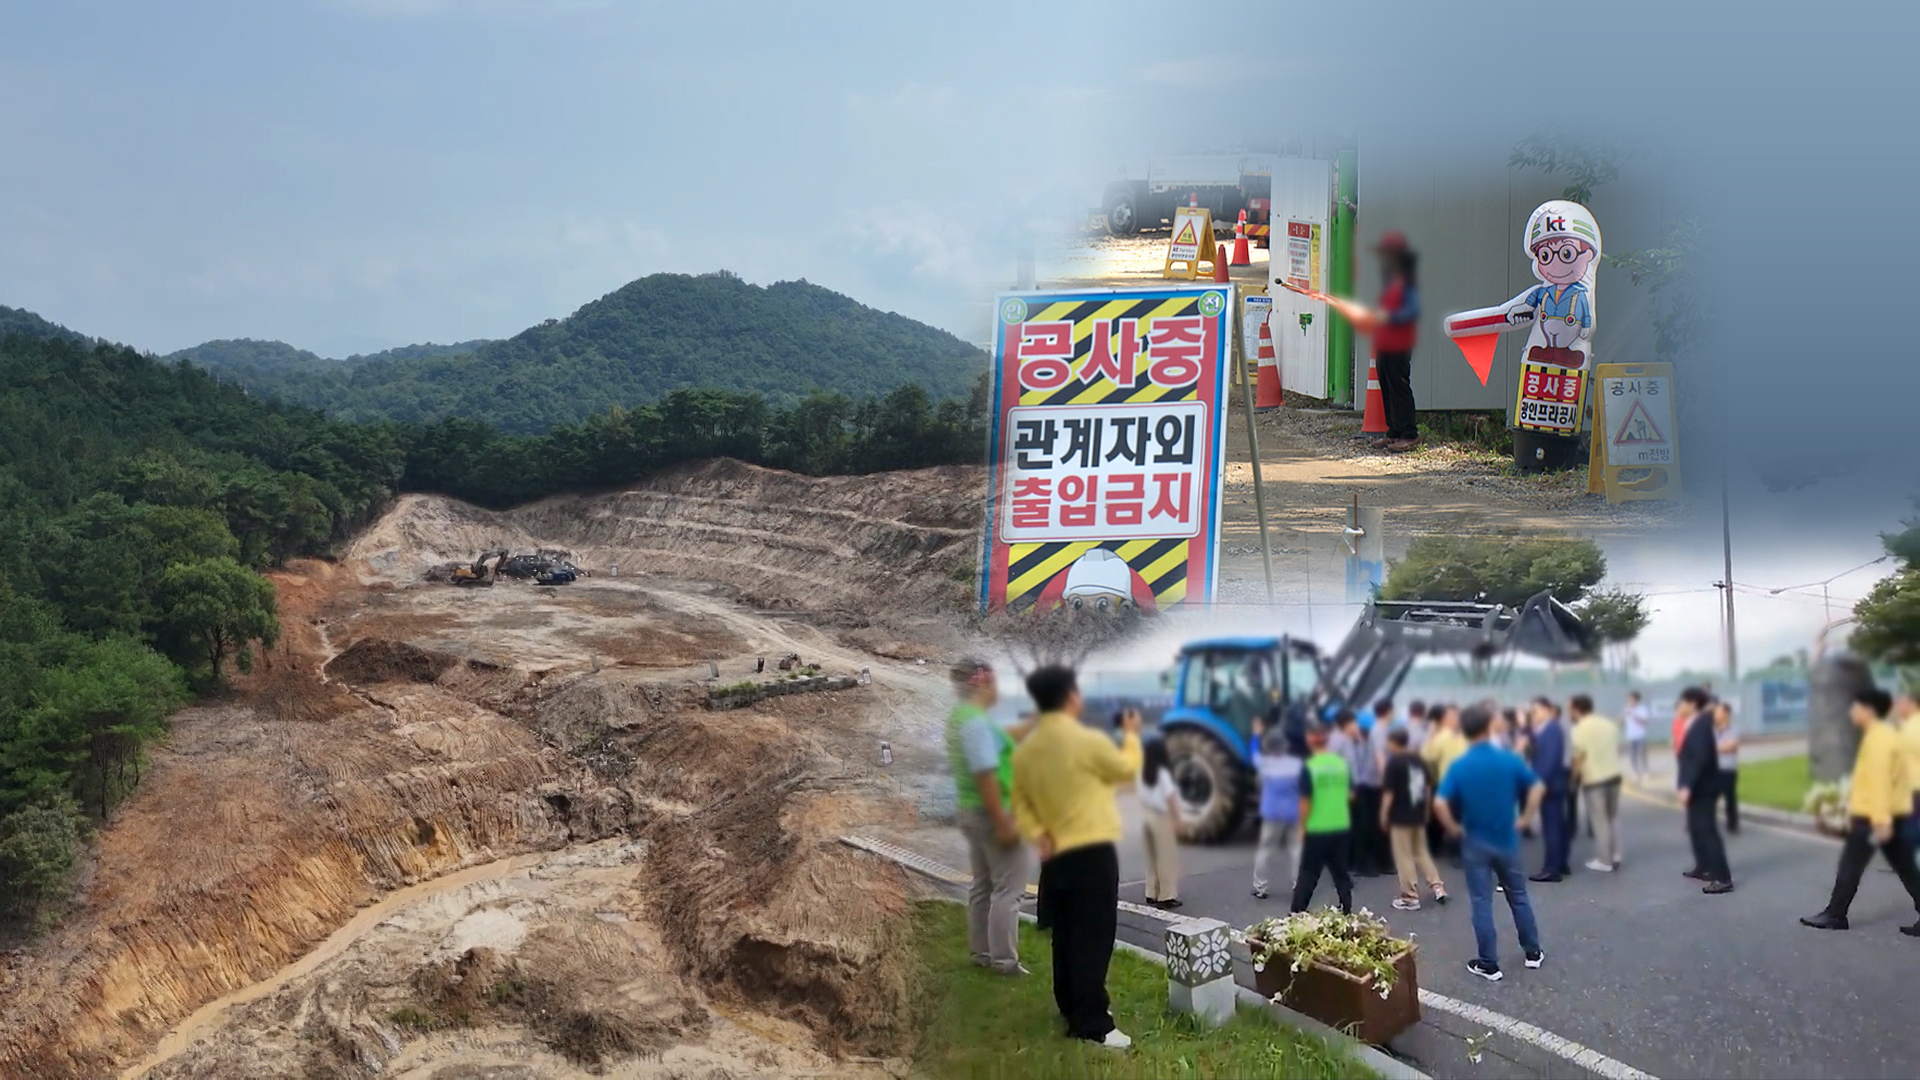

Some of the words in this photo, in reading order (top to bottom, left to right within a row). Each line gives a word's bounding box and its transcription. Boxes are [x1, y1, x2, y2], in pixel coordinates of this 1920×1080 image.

[1546, 216, 1566, 232] kt
[1005, 304, 1022, 320] 안
[1203, 296, 1220, 313] 전
[1018, 315, 1207, 391] 공사중
[1527, 374, 1577, 398] 공사중
[1611, 380, 1660, 396] 공사중
[1014, 414, 1196, 470] 관계자외
[1012, 472, 1192, 529] 출입금지
